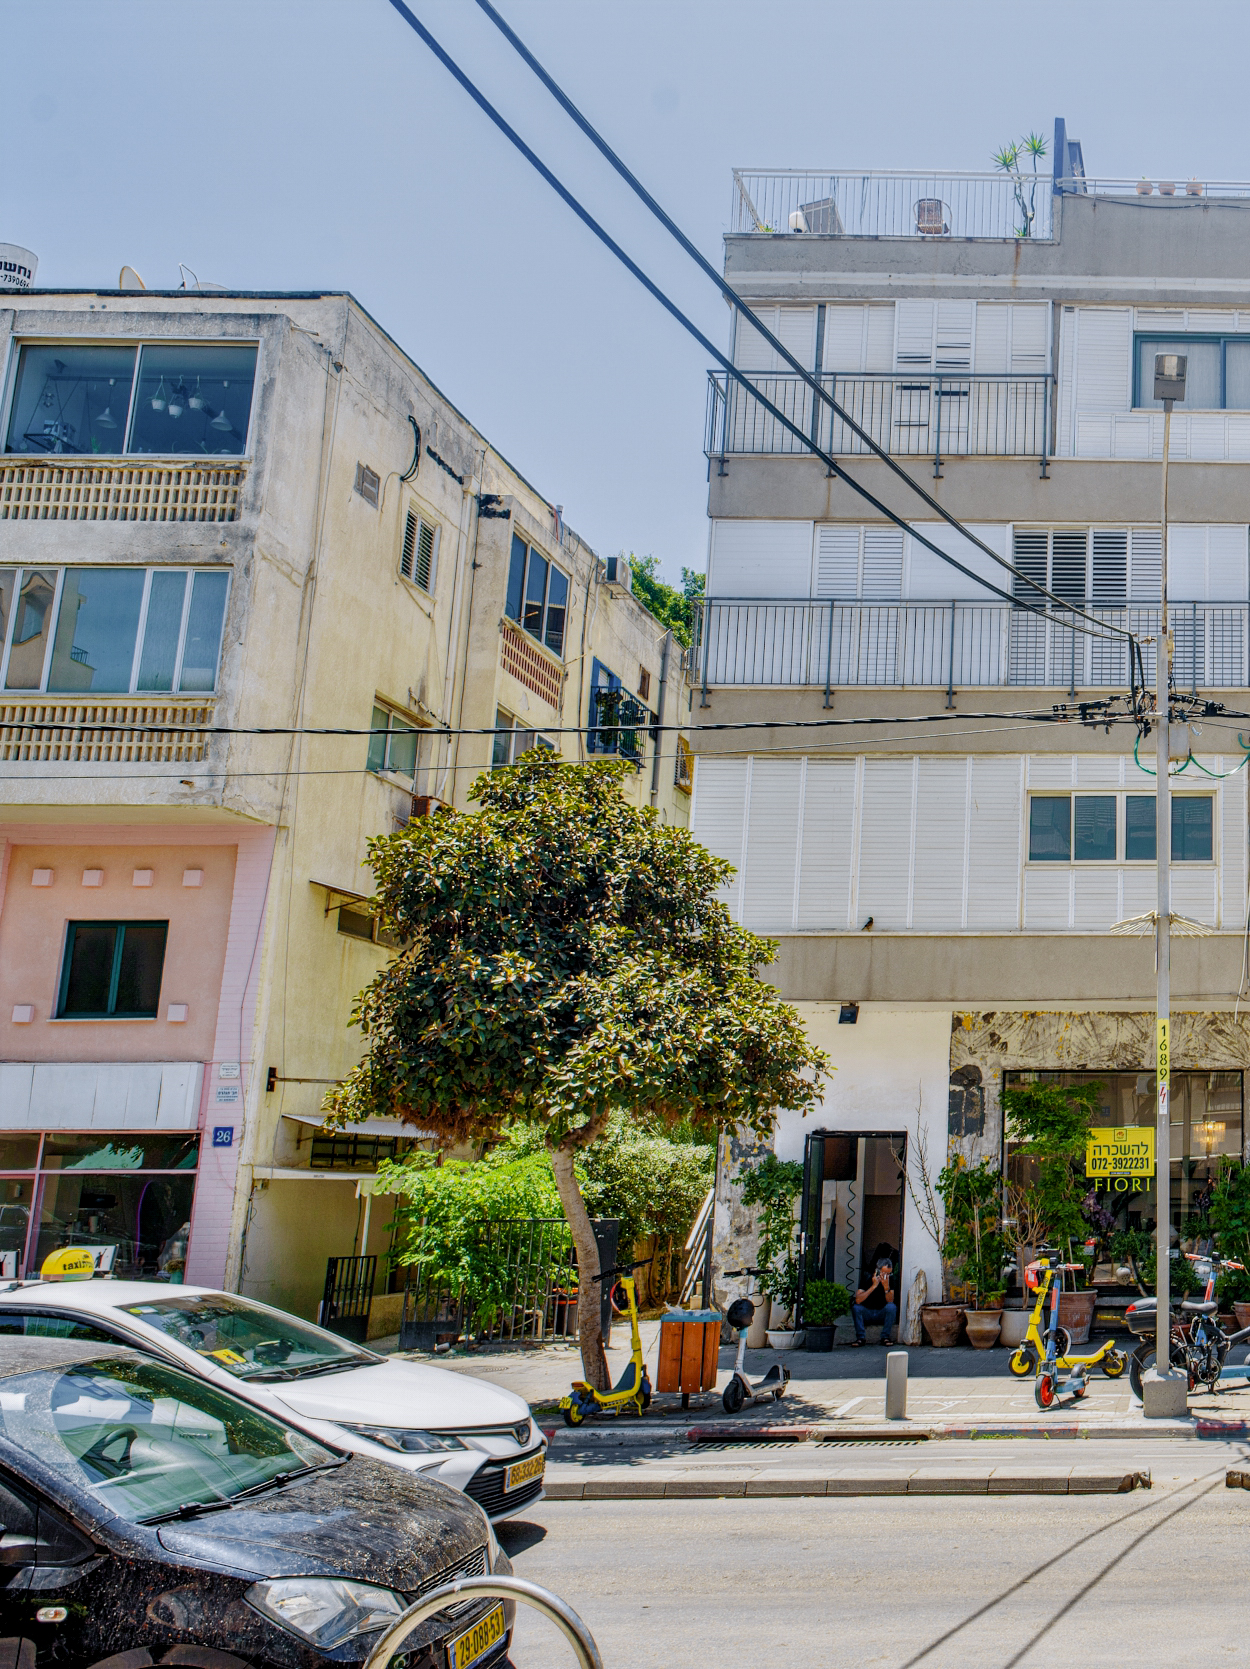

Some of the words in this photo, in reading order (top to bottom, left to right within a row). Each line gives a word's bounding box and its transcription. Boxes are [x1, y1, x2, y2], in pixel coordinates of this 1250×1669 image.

[1159, 1024, 1168, 1081] 1689
[215, 1130, 231, 1143] 26
[1093, 1141, 1149, 1156] להשכרה
[1091, 1157, 1150, 1170] 072-3922231
[1094, 1178, 1151, 1192] FIORI
[63, 1259, 82, 1271] taxi
